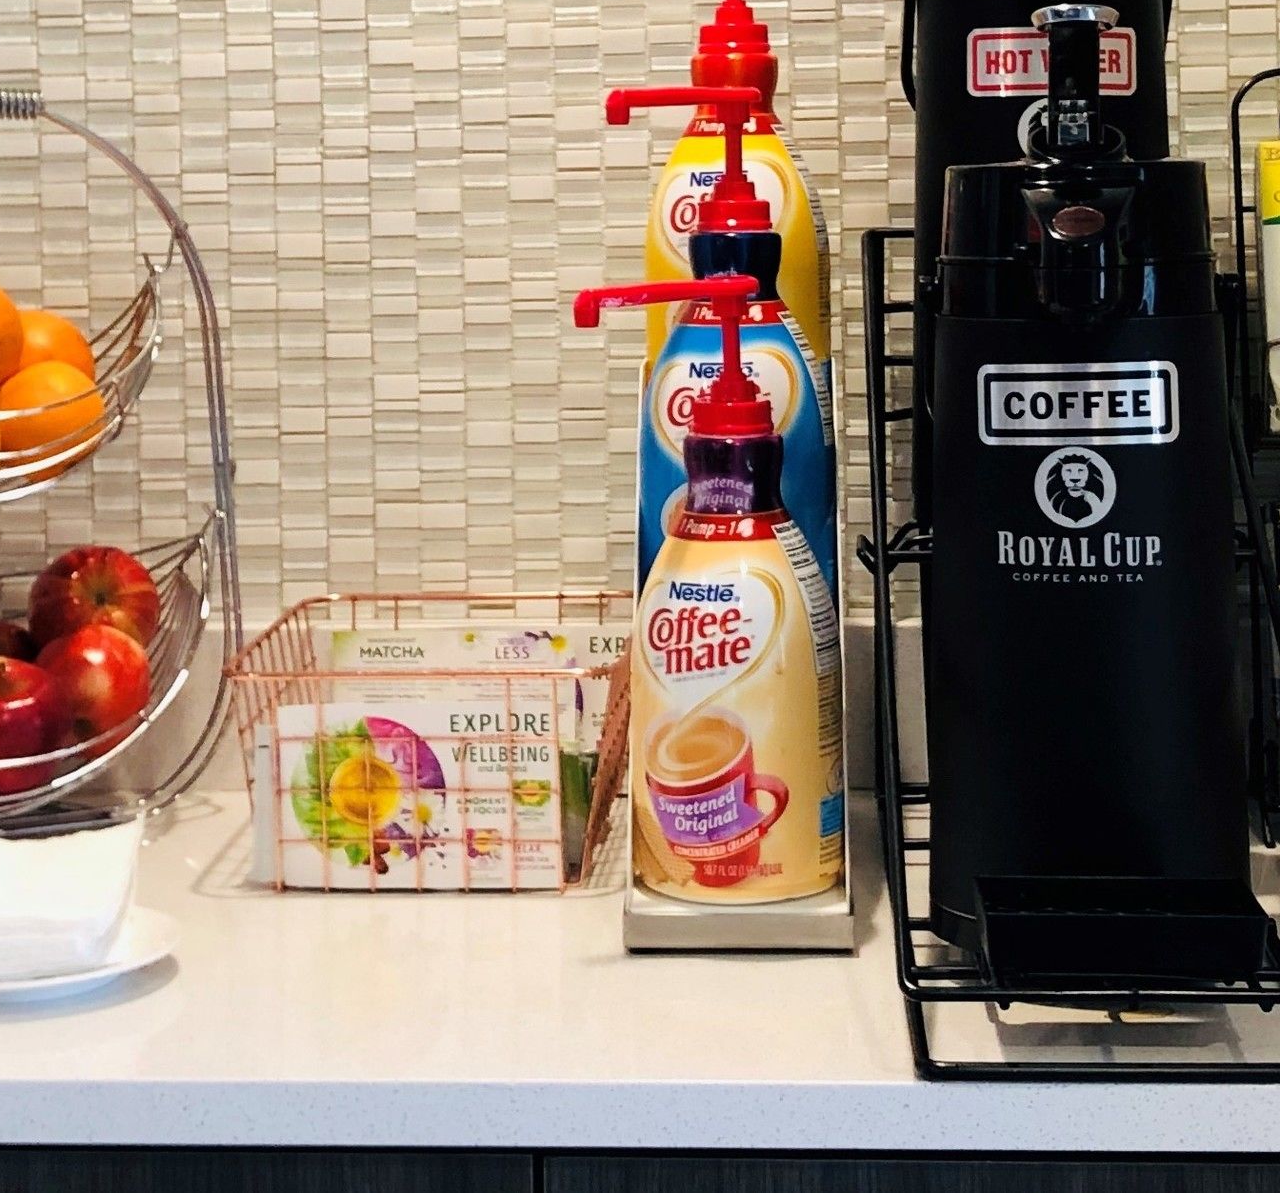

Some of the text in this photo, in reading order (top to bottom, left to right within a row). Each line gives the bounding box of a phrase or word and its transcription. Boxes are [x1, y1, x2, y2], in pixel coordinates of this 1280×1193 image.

[985, 49, 1032, 74] HOT
[1004, 390, 1151, 420] COFFEE
[685, 518, 716, 539] Pump
[997, 530, 1161, 567] ROYAL CUP
[1013, 573, 1144, 583] COFFEE AND TEA
[360, 645, 424, 658] MATCHA
[495, 646, 530, 659] LESS
[665, 636, 751, 675] mate
[450, 713, 550, 736] EXPLORE
[452, 743, 549, 763] WELLBEING
[658, 784, 736, 816] Sweetened
[675, 804, 739, 835] Original
